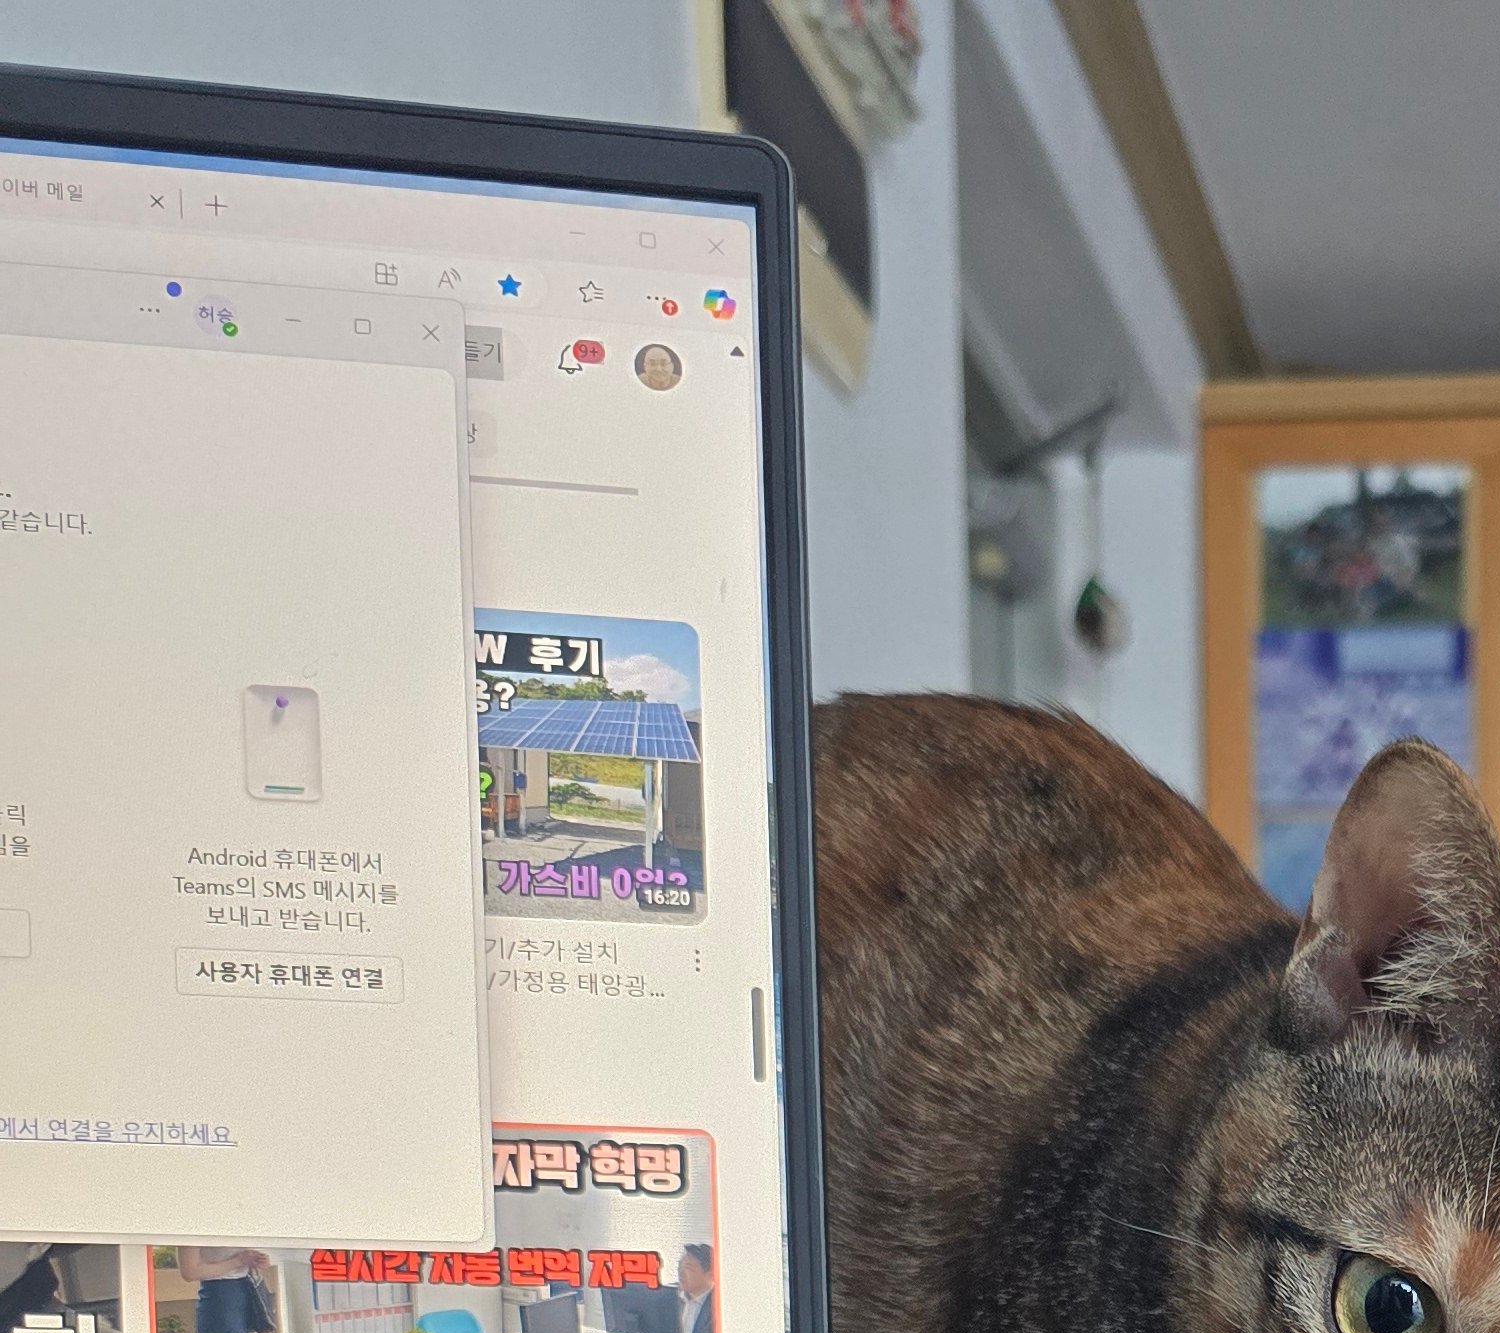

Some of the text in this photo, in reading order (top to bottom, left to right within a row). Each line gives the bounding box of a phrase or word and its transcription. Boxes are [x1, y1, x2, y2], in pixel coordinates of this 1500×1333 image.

[47, 182, 84, 202] 메일
[578, 344, 599, 358] 9+
[0, 509, 92, 535] 같습니다.
[529, 637, 601, 676] 후기
[188, 847, 383, 875] Android 휴대폰에서
[173, 876, 399, 905] Teams의 SMS 메시지를
[499, 861, 599, 898] 가스비
[644, 889, 690, 906] 16:20
[205, 906, 371, 933] 보내고 받습니다.
[574, 941, 617, 965] 설치
[195, 961, 384, 989] 사용자 휴대폰 연결
[0, 1117, 38, 1140] 에서
[49, 1118, 114, 1142] 연결을
[589, 1141, 682, 1193] 혁명
[312, 1249, 660, 1289] 실시간 자동 번역 자막
